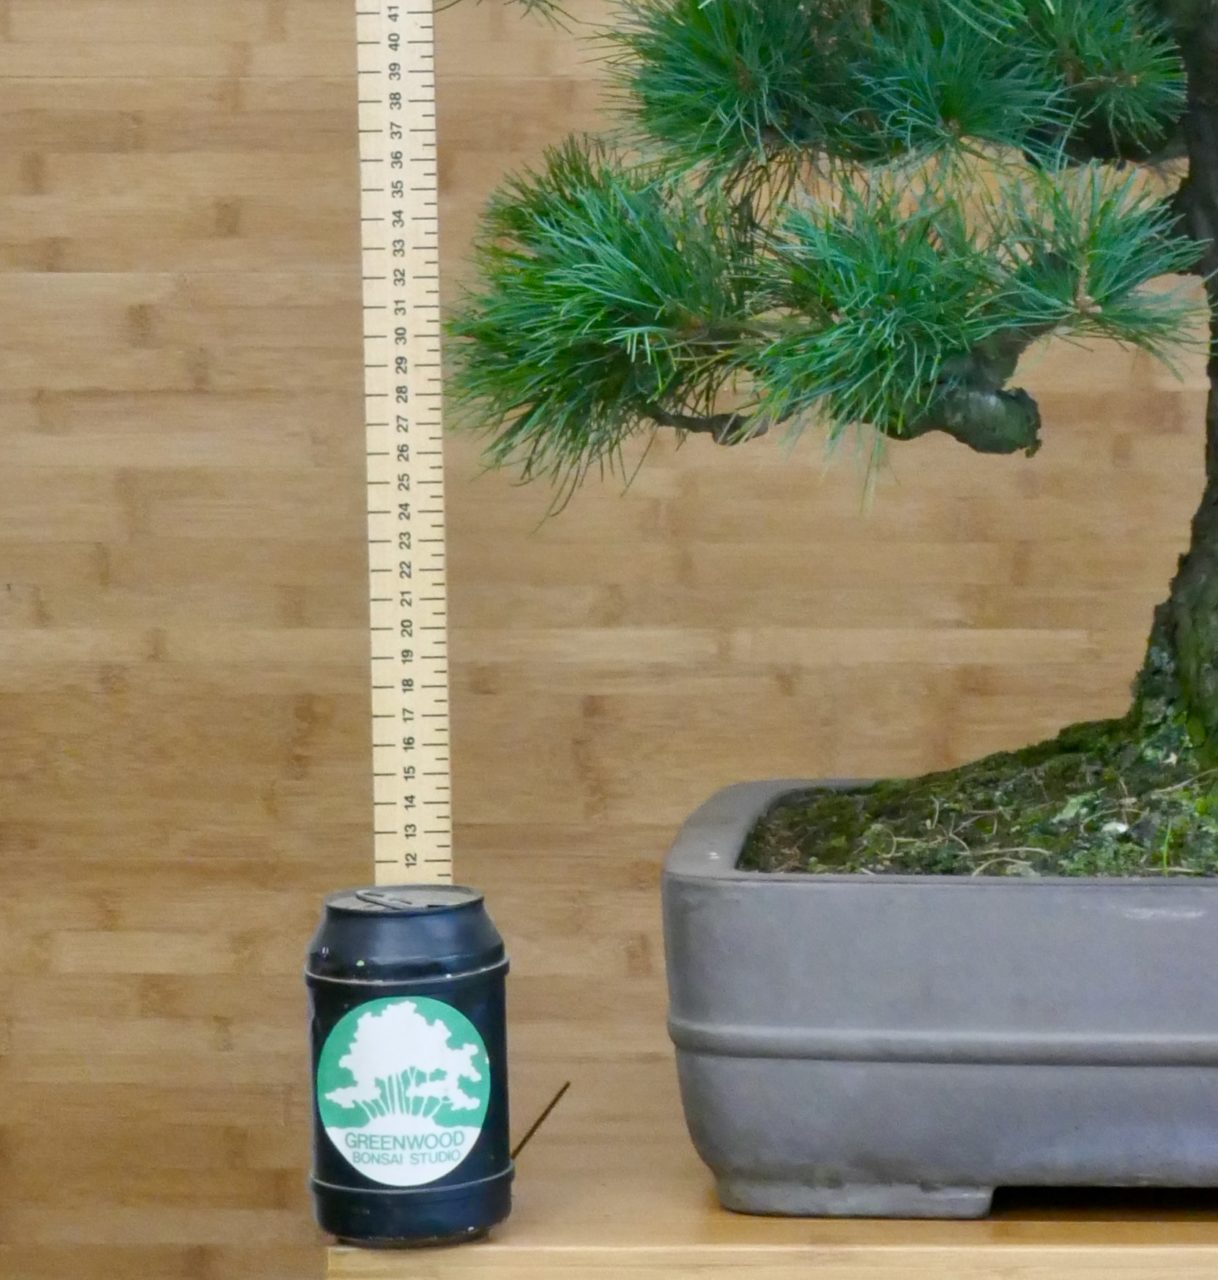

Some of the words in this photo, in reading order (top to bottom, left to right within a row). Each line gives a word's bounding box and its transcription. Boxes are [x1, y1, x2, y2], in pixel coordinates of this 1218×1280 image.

[386, 5, 400, 23] 41
[387, 32, 401, 52] 40
[388, 61, 402, 81] 39
[388, 91, 402, 111] 38
[389, 121, 403, 140] 37
[390, 150, 404, 170] 36
[390, 179, 404, 199] 35
[391, 209, 405, 228] 34
[391, 238, 406, 258] 33
[392, 268, 406, 287] 32
[393, 299, 407, 316] 31
[393, 326, 408, 346] 30
[394, 355, 408, 375] 29
[394, 384, 409, 404] 28
[395, 414, 409, 434] 27
[396, 443, 410, 463] 26
[396, 472, 411, 492] 25
[397, 502, 411, 521] 24
[398, 531, 412, 550] 23
[398, 560, 412, 580] 22
[399, 590, 413, 608] 21
[400, 618, 414, 638] 20
[400, 648, 414, 665] 19
[401, 677, 415, 694] 18
[401, 707, 415, 723] 17
[402, 736, 416, 752] 16
[402, 765, 416, 782] 15
[403, 794, 417, 811] 14
[403, 823, 417, 840] 13
[404, 852, 418, 869] 12
[345, 1130, 465, 1151] GREENWOOD
[352, 1151, 404, 1166] BONSAI
[409, 1149, 461, 1165] STUDIO
